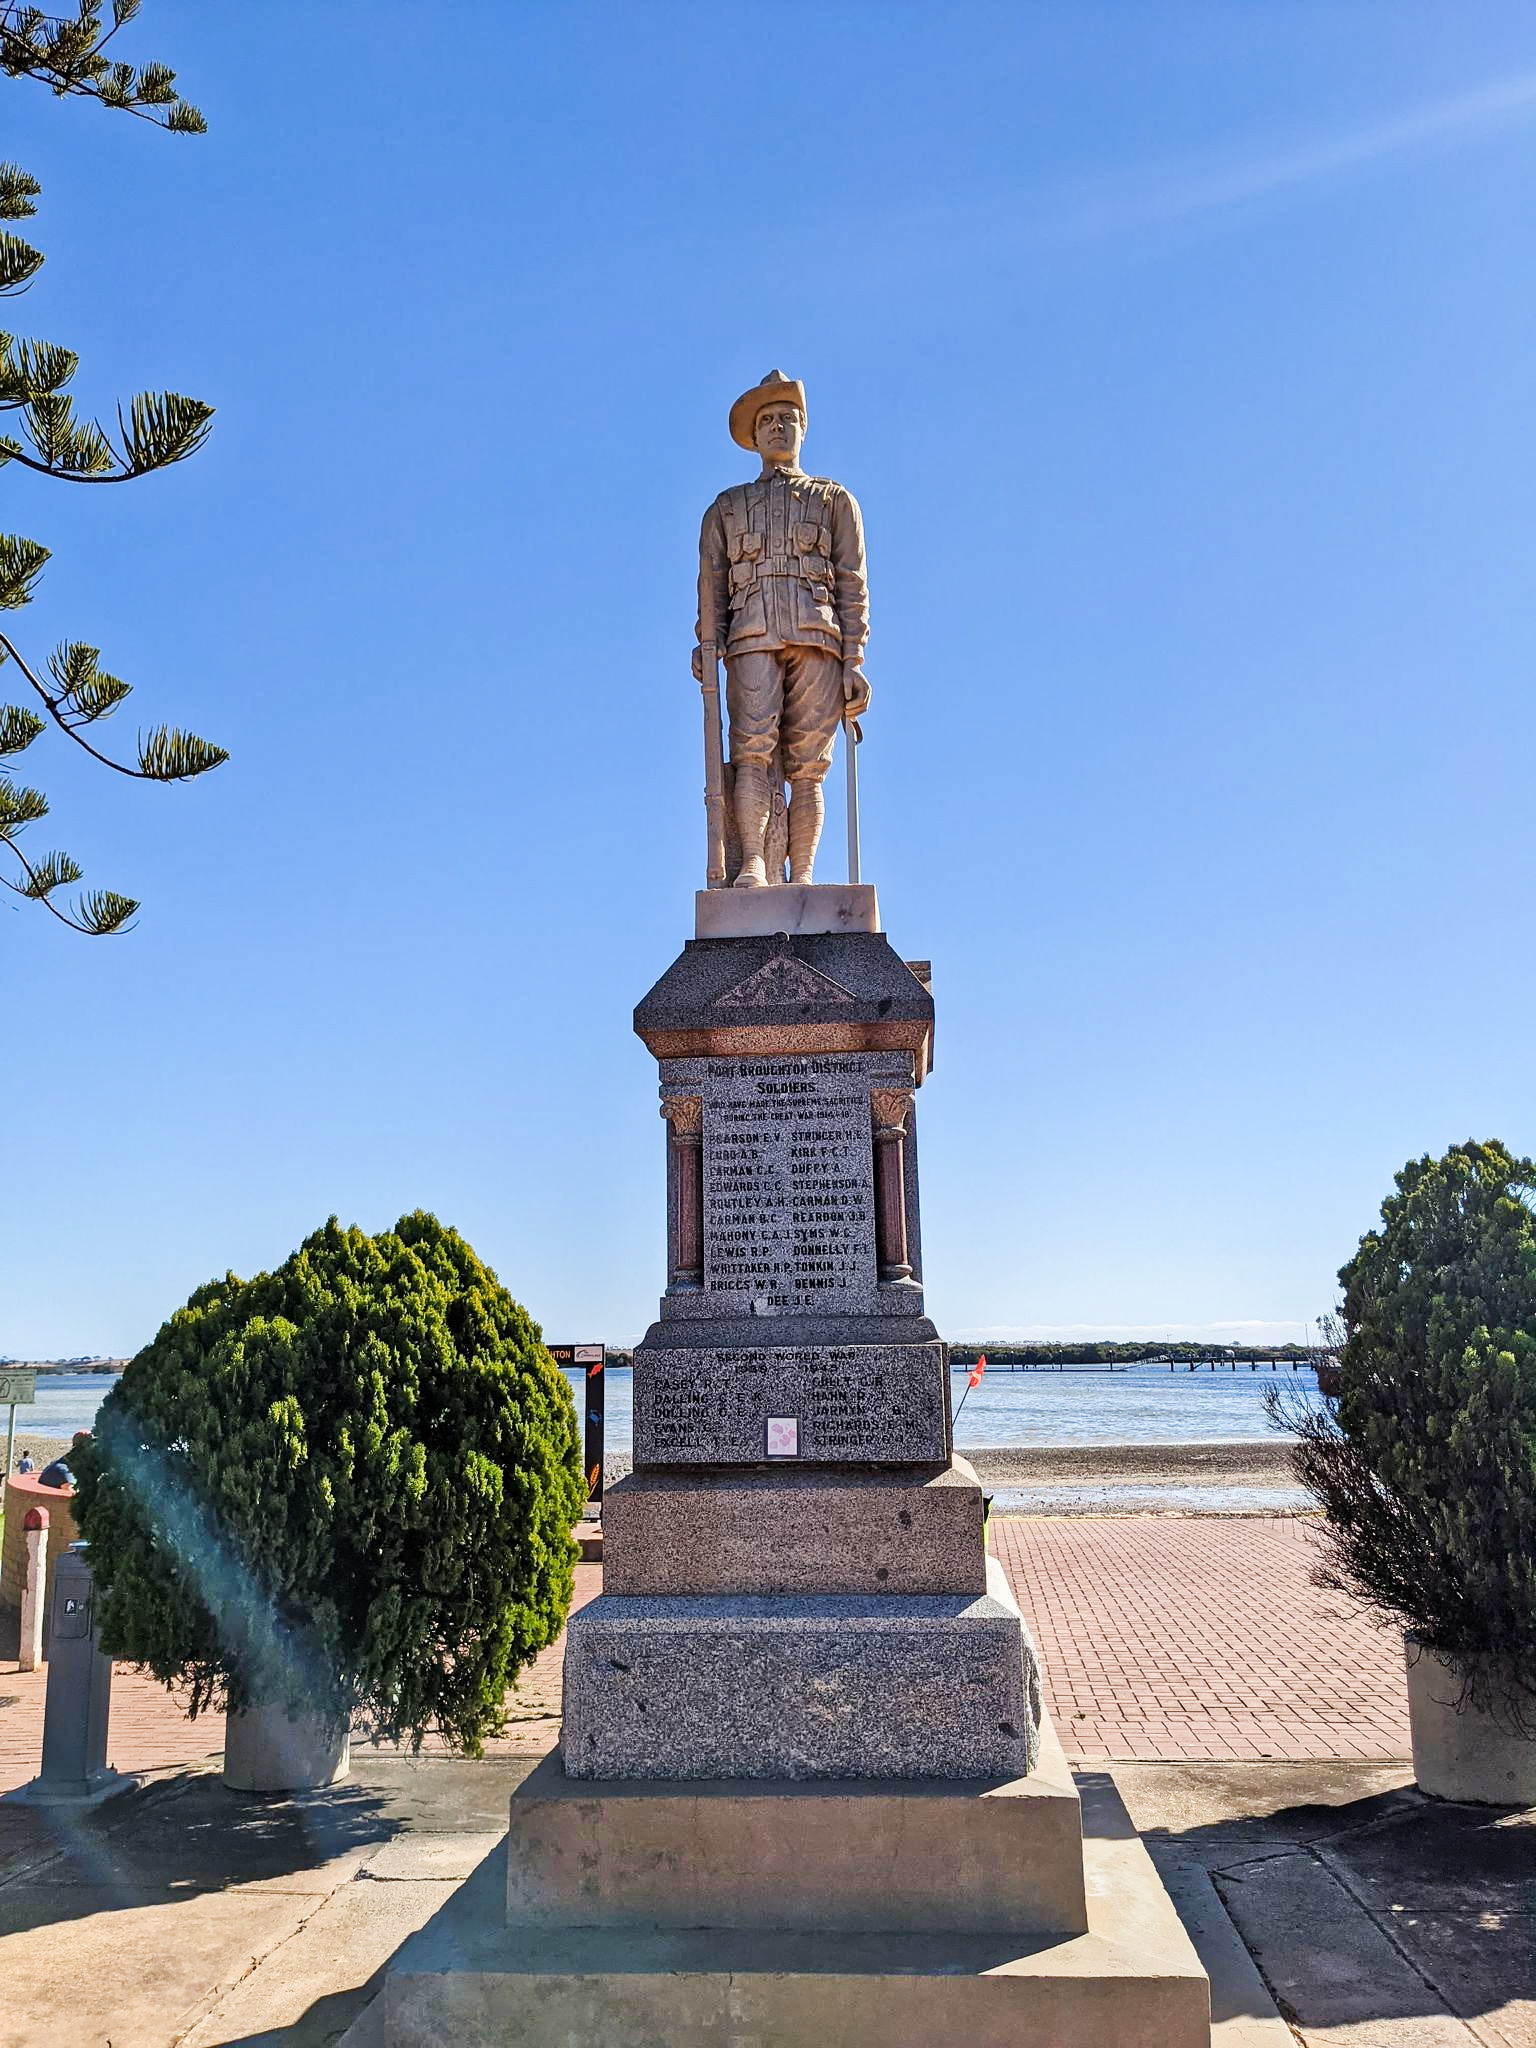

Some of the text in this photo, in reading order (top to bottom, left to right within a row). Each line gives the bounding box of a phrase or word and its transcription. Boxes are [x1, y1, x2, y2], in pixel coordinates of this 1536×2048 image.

[708, 1061, 862, 1078] PORT BROUGHTON DISTRICT
[729, 1100, 746, 1108] HAVE
[749, 1100, 769, 1108] MADE
[773, 1099, 786, 1107] THE
[789, 1098, 821, 1106] SUPREME
[771, 1112, 793, 1120] GREAT
[709, 1134, 759, 1144] PEARSON
[791, 1131, 842, 1142] STRINGER
[791, 1147, 817, 1157] KIRK
[791, 1163, 828, 1174] DUFFY
[709, 1181, 759, 1192] EDWARDS
[793, 1180, 858, 1190] STEPHENSON
[710, 1198, 761, 1209] ROUTLEY
[793, 1195, 838, 1206] CARMAN
[793, 1212, 844, 1222] REARDON
[710, 1231, 756, 1241] MAHONY
[794, 1229, 825, 1239] SYMS
[710, 1247, 746, 1258] LEWIS
[793, 1244, 849, 1255] DONNELLY
[710, 1262, 770, 1274] WHITTAKER
[795, 1261, 833, 1272] TONKIN
[710, 1280, 749, 1291] BRIGGS
[795, 1278, 834, 1289] DENNIS
[767, 1295, 789, 1306] DEE
[716, 1352, 856, 1362] SECOND WORLD WAR
[735, 1365, 768, 1373] 1939
[802, 1364, 838, 1373] 1945
[655, 1379, 695, 1390] CASEY
[655, 1393, 709, 1404] DALLING
[812, 1391, 848, 1401] HAHN
[655, 1423, 694, 1433] EVANS
[813, 1420, 879, 1431] RICHARDS
[655, 1437, 704, 1447] EXCELL
[814, 1435, 873, 1446] STRINGER
